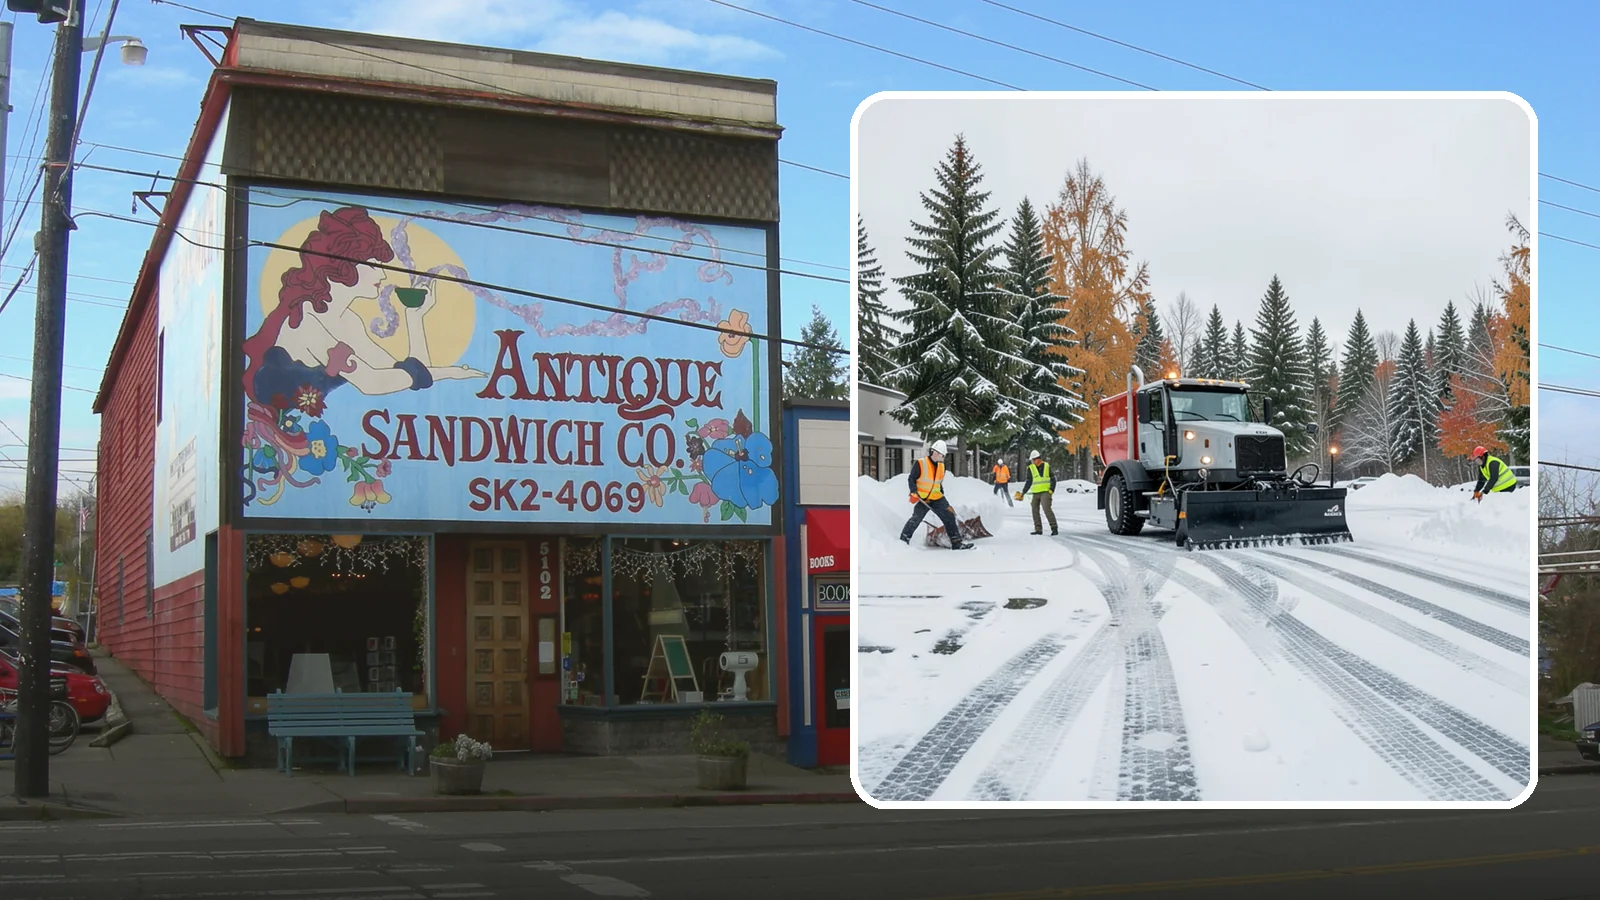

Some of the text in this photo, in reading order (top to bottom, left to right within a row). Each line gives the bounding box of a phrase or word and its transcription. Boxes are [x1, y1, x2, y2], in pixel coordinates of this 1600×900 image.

[476, 329, 723, 420] ANTIQUE
[362, 409, 685, 468] SANDWICH CO.
[469, 477, 645, 513] SK2-4069
[540, 542, 552, 599] 5102
[809, 555, 835, 569] BOOKS
